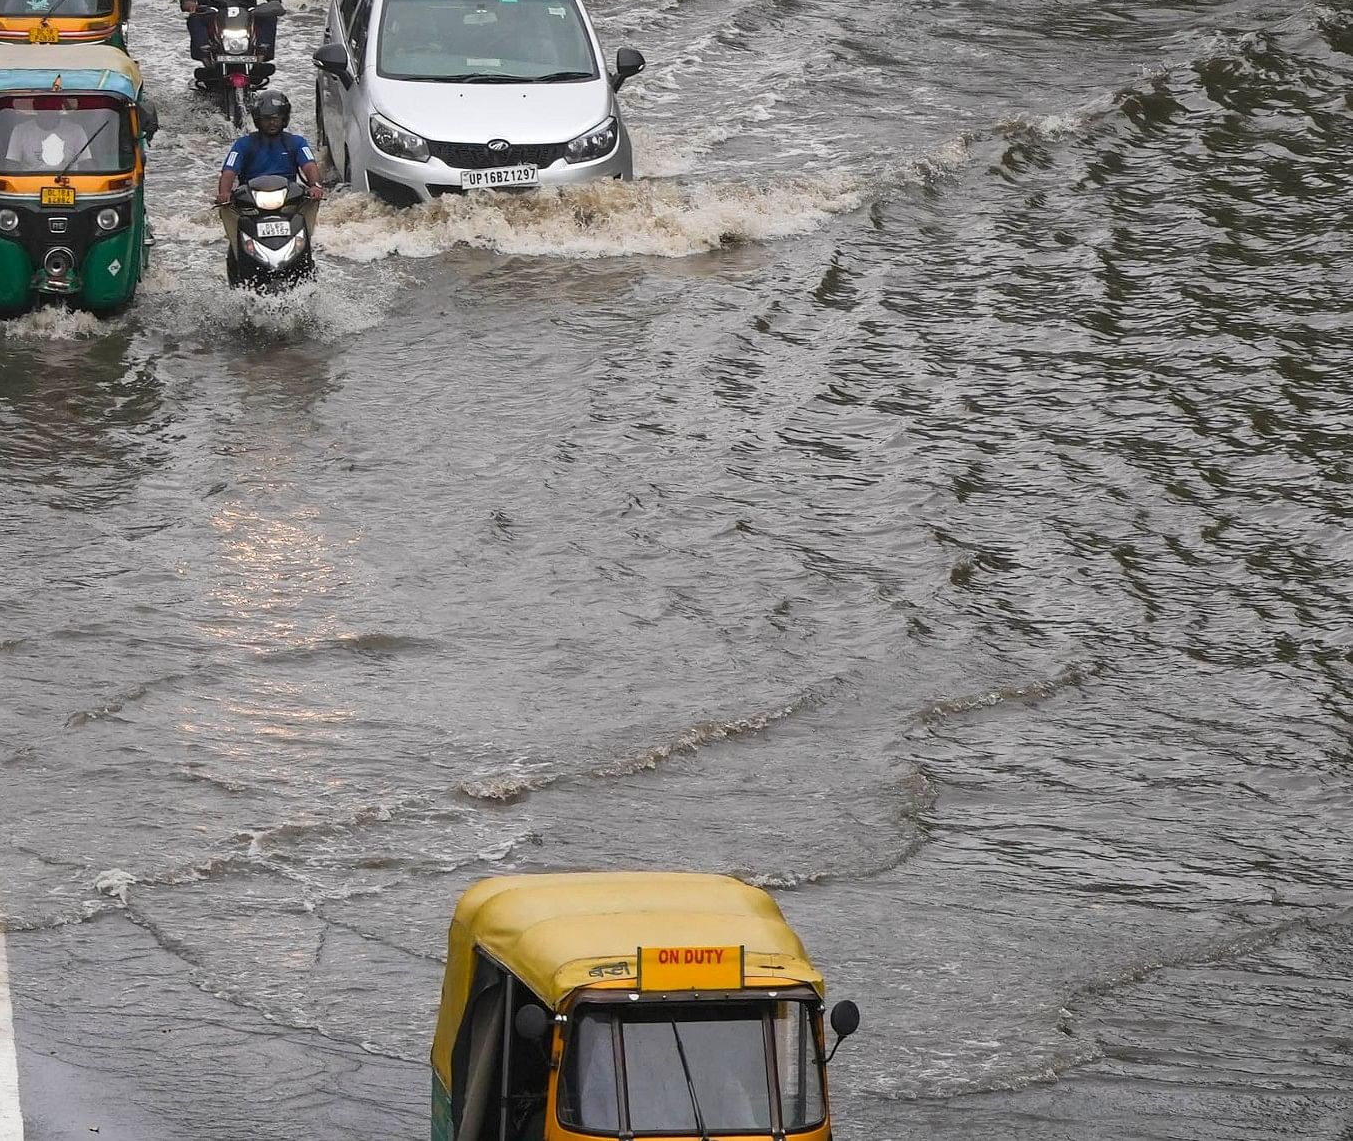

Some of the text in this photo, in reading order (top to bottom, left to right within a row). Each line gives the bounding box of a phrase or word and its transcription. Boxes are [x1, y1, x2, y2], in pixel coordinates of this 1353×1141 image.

[468, 168, 537, 185] UP16BZ1297
[52, 222, 65, 230] RE
[658, 949, 724, 965] ON DUTY
